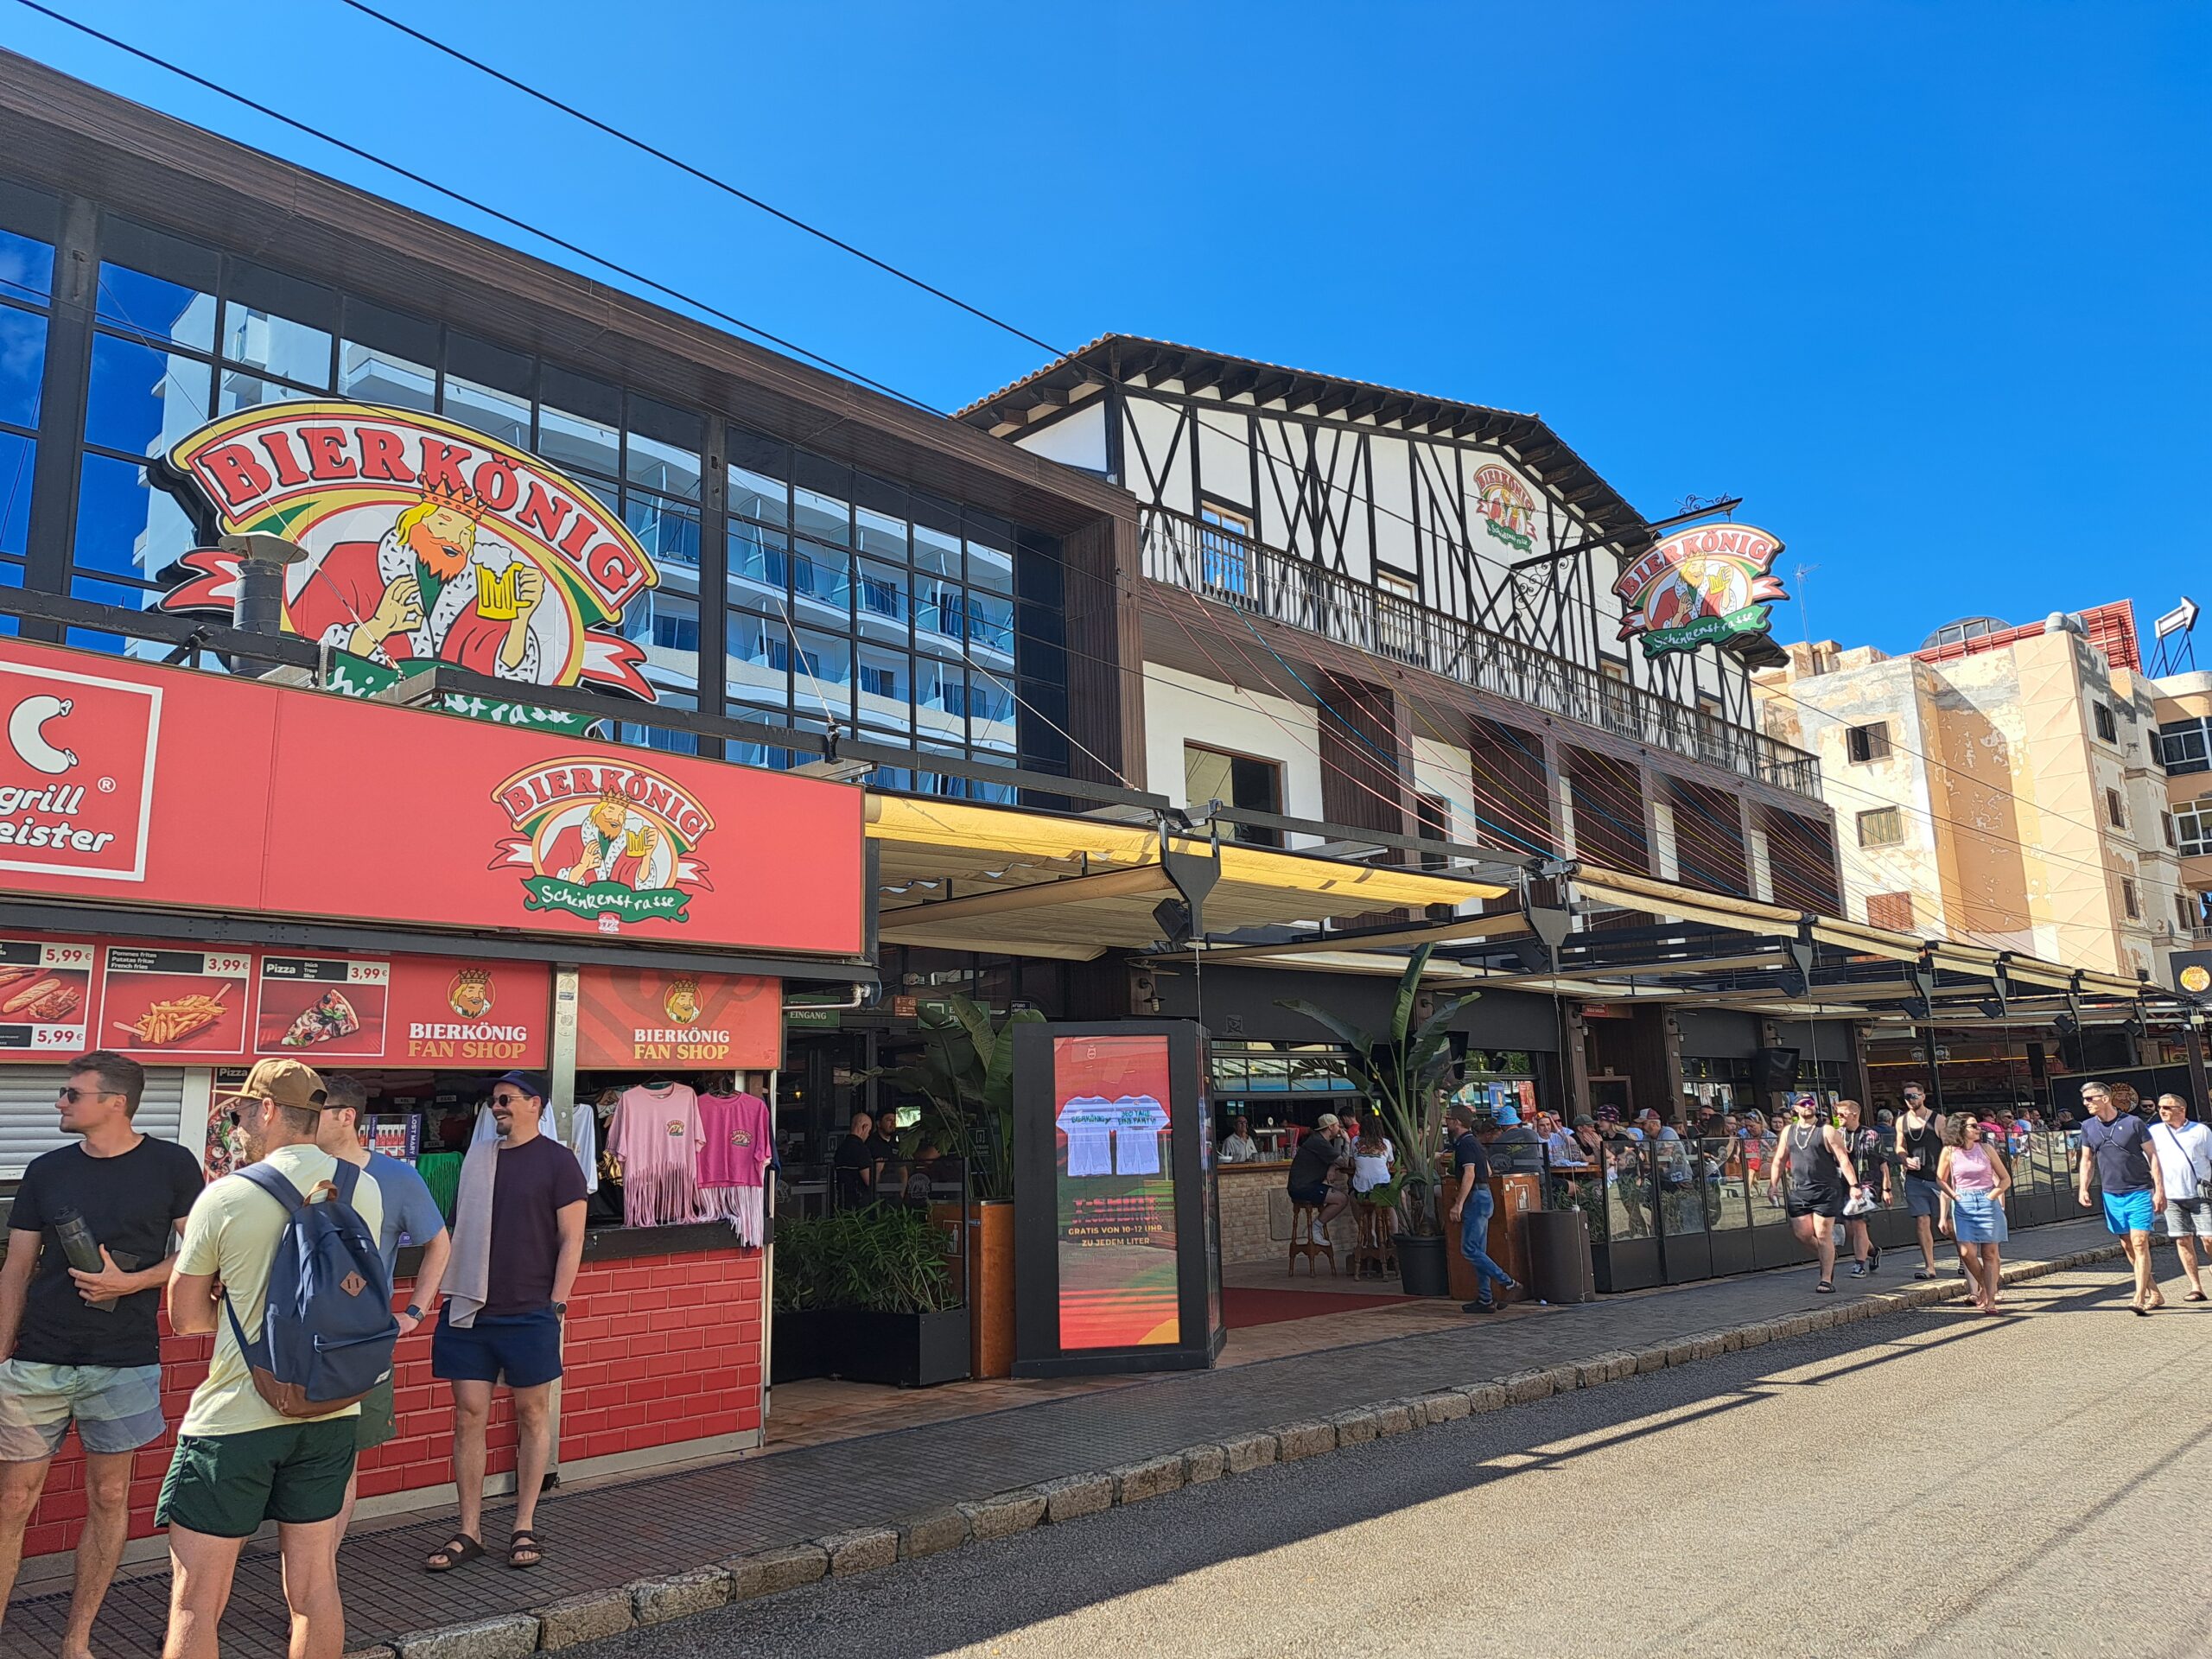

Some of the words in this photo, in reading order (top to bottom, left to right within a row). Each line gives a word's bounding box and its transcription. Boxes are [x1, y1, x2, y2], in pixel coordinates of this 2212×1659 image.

[201, 426, 637, 595] BIERKÖNIG
[1619, 528, 1770, 599] BIERKÖNIG
[1654, 610, 1756, 650] Schinkenstrasse
[0, 784, 86, 816] grill
[503, 767, 706, 837] BIERKÖNIG
[541, 885, 677, 912] Schinkenstrasse
[266, 963, 296, 974] Pizza
[790, 1011, 827, 1020] EINGANG
[410, 1021, 527, 1041] BIERKÖNIG
[634, 1027, 730, 1043] BIERKÖNIG
[408, 1039, 456, 1058] FAN
[461, 1041, 527, 1059] SHOP
[634, 1044, 671, 1059] FAN
[676, 1044, 730, 1060] SHOP
[219, 1067, 248, 1077] Pizza
[1068, 1227, 1099, 1236] GRATIS
[1101, 1225, 1120, 1234] VON
[1122, 1224, 1142, 1233] 10-12
[1096, 1237, 1124, 1246] JEDEM
[1127, 1236, 1150, 1245] LITER
